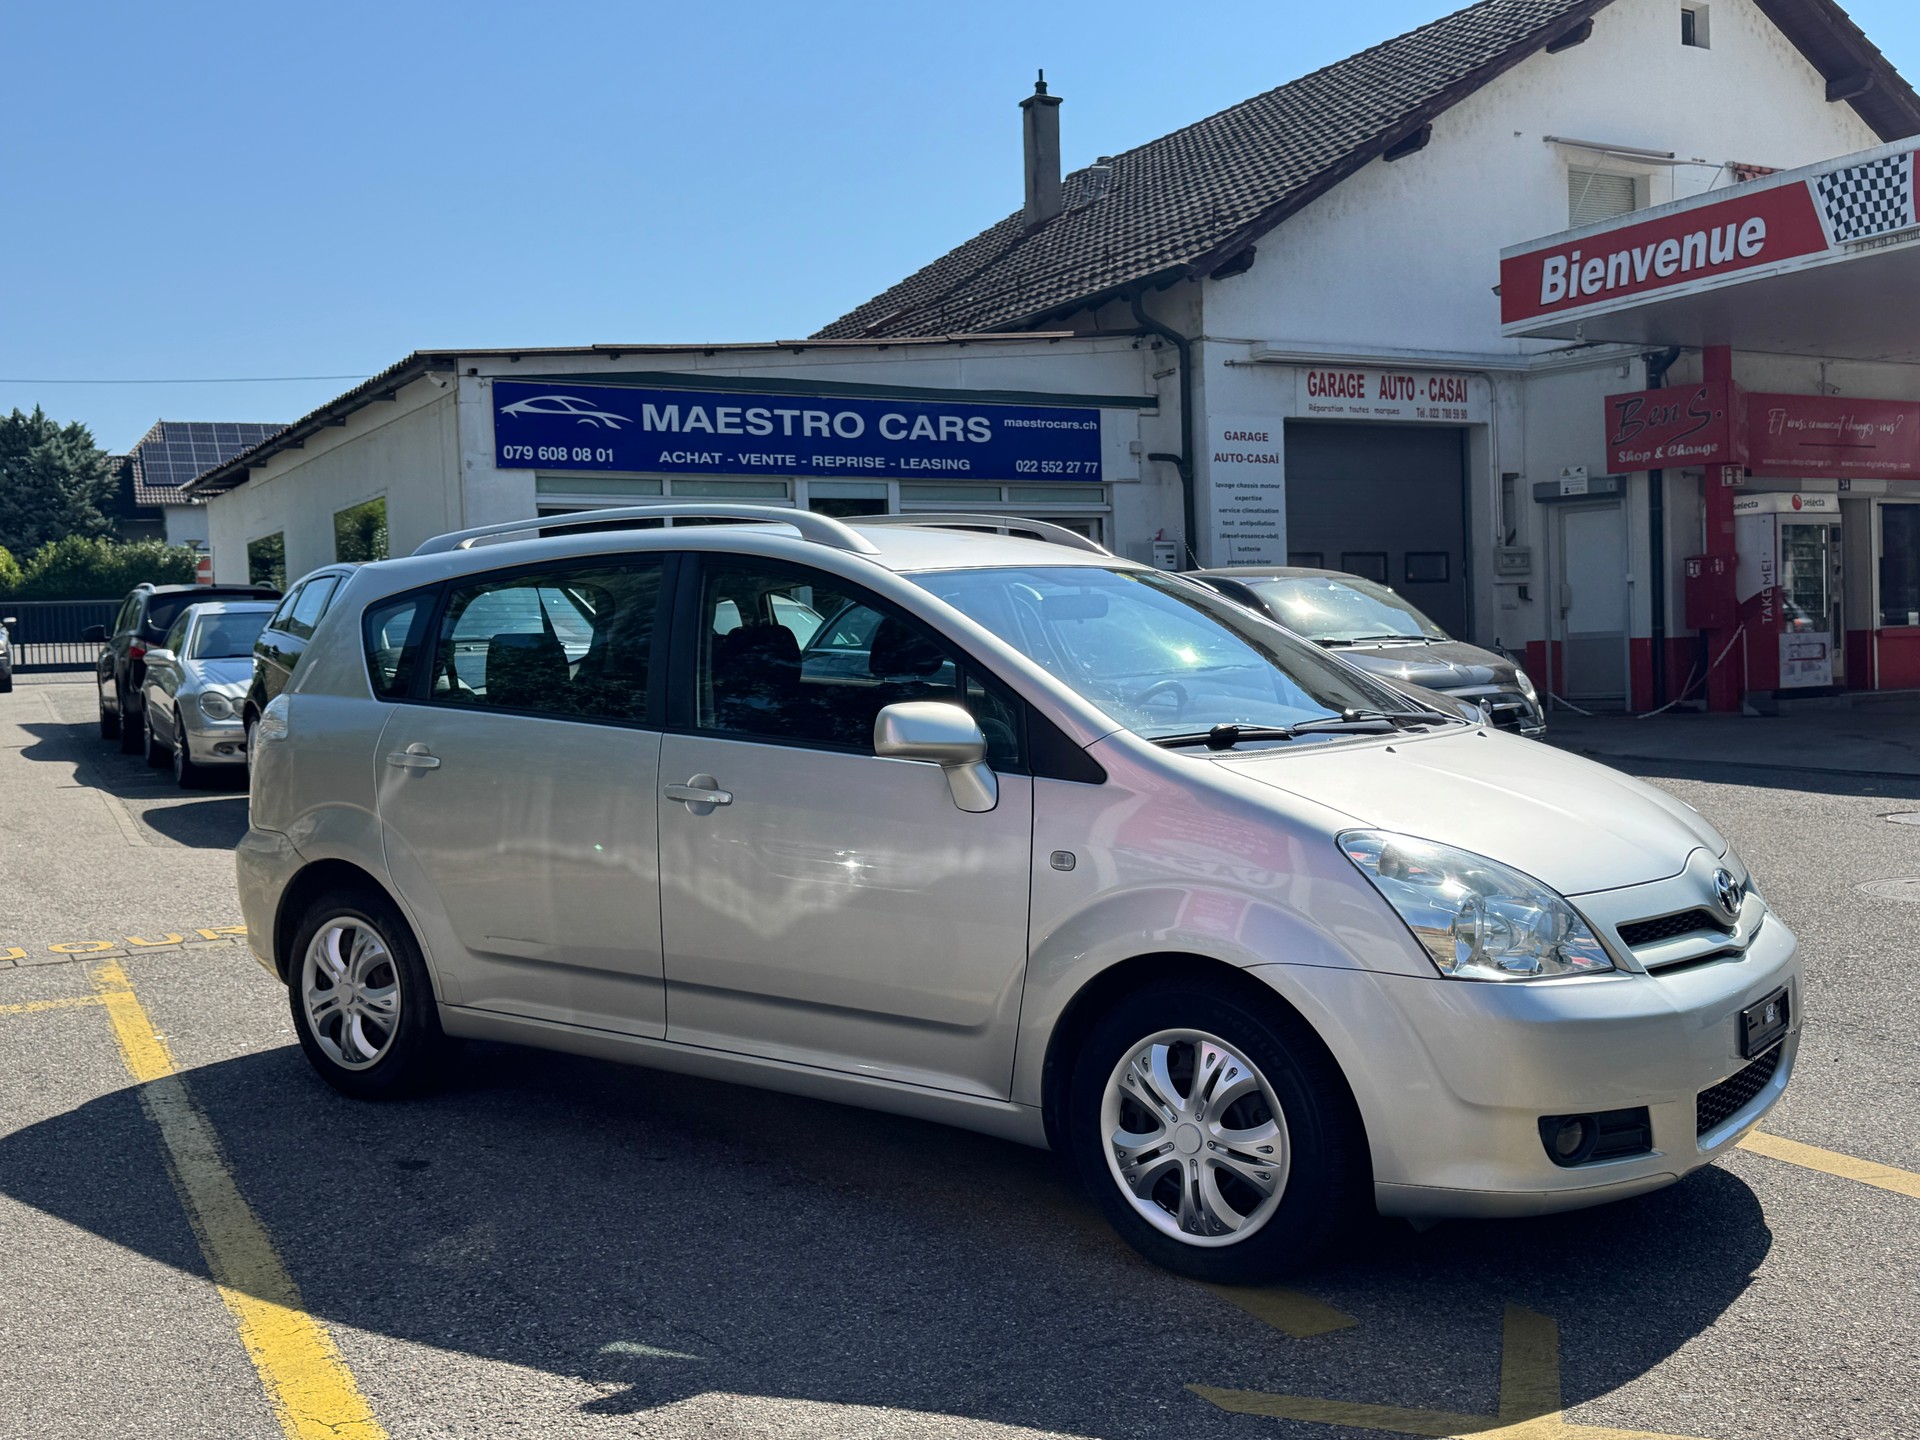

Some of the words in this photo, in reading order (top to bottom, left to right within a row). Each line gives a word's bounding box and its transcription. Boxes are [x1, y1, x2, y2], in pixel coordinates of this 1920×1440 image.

[1540, 216, 1766, 306] Bienvenue
[1307, 371, 1365, 399] GARAGE
[1379, 375, 1415, 401] AUTO
[1308, 403, 1344, 413] Réparation
[1349, 405, 1370, 414] toutes
[1374, 408, 1400, 417] marques
[642, 403, 866, 440] MAESTRO
[878, 413, 992, 443] CARS
[1003, 418, 1098, 431] maestrocars.ch
[1610, 396, 1679, 447] Ben
[1768, 408, 1788, 435] Et
[1224, 430, 1269, 442] GARAGE
[503, 445, 533, 461] 079
[537, 446, 568, 462] 608
[572, 447, 592, 462] 08
[596, 448, 614, 463] 01
[659, 451, 723, 465] ACHAT
[738, 453, 797, 466] VENTE
[812, 455, 885, 469] REPRISE
[900, 458, 971, 471] LEASING
[1618, 449, 1651, 463] Shop
[1654, 446, 1664, 459] &
[1667, 443, 1718, 456] Change
[1015, 459, 1038, 473] 022
[1041, 460, 1063, 473] 552
[1066, 461, 1081, 474] 27
[1083, 462, 1098, 474] 77
[1840, 480, 1850, 490] 34
[1803, 498, 1825, 507] selecta
[1761, 560, 1773, 588] ME!
[1761, 588, 1773, 624] TAKE
[1212, 1007, 1285, 1068] MICHELIN
